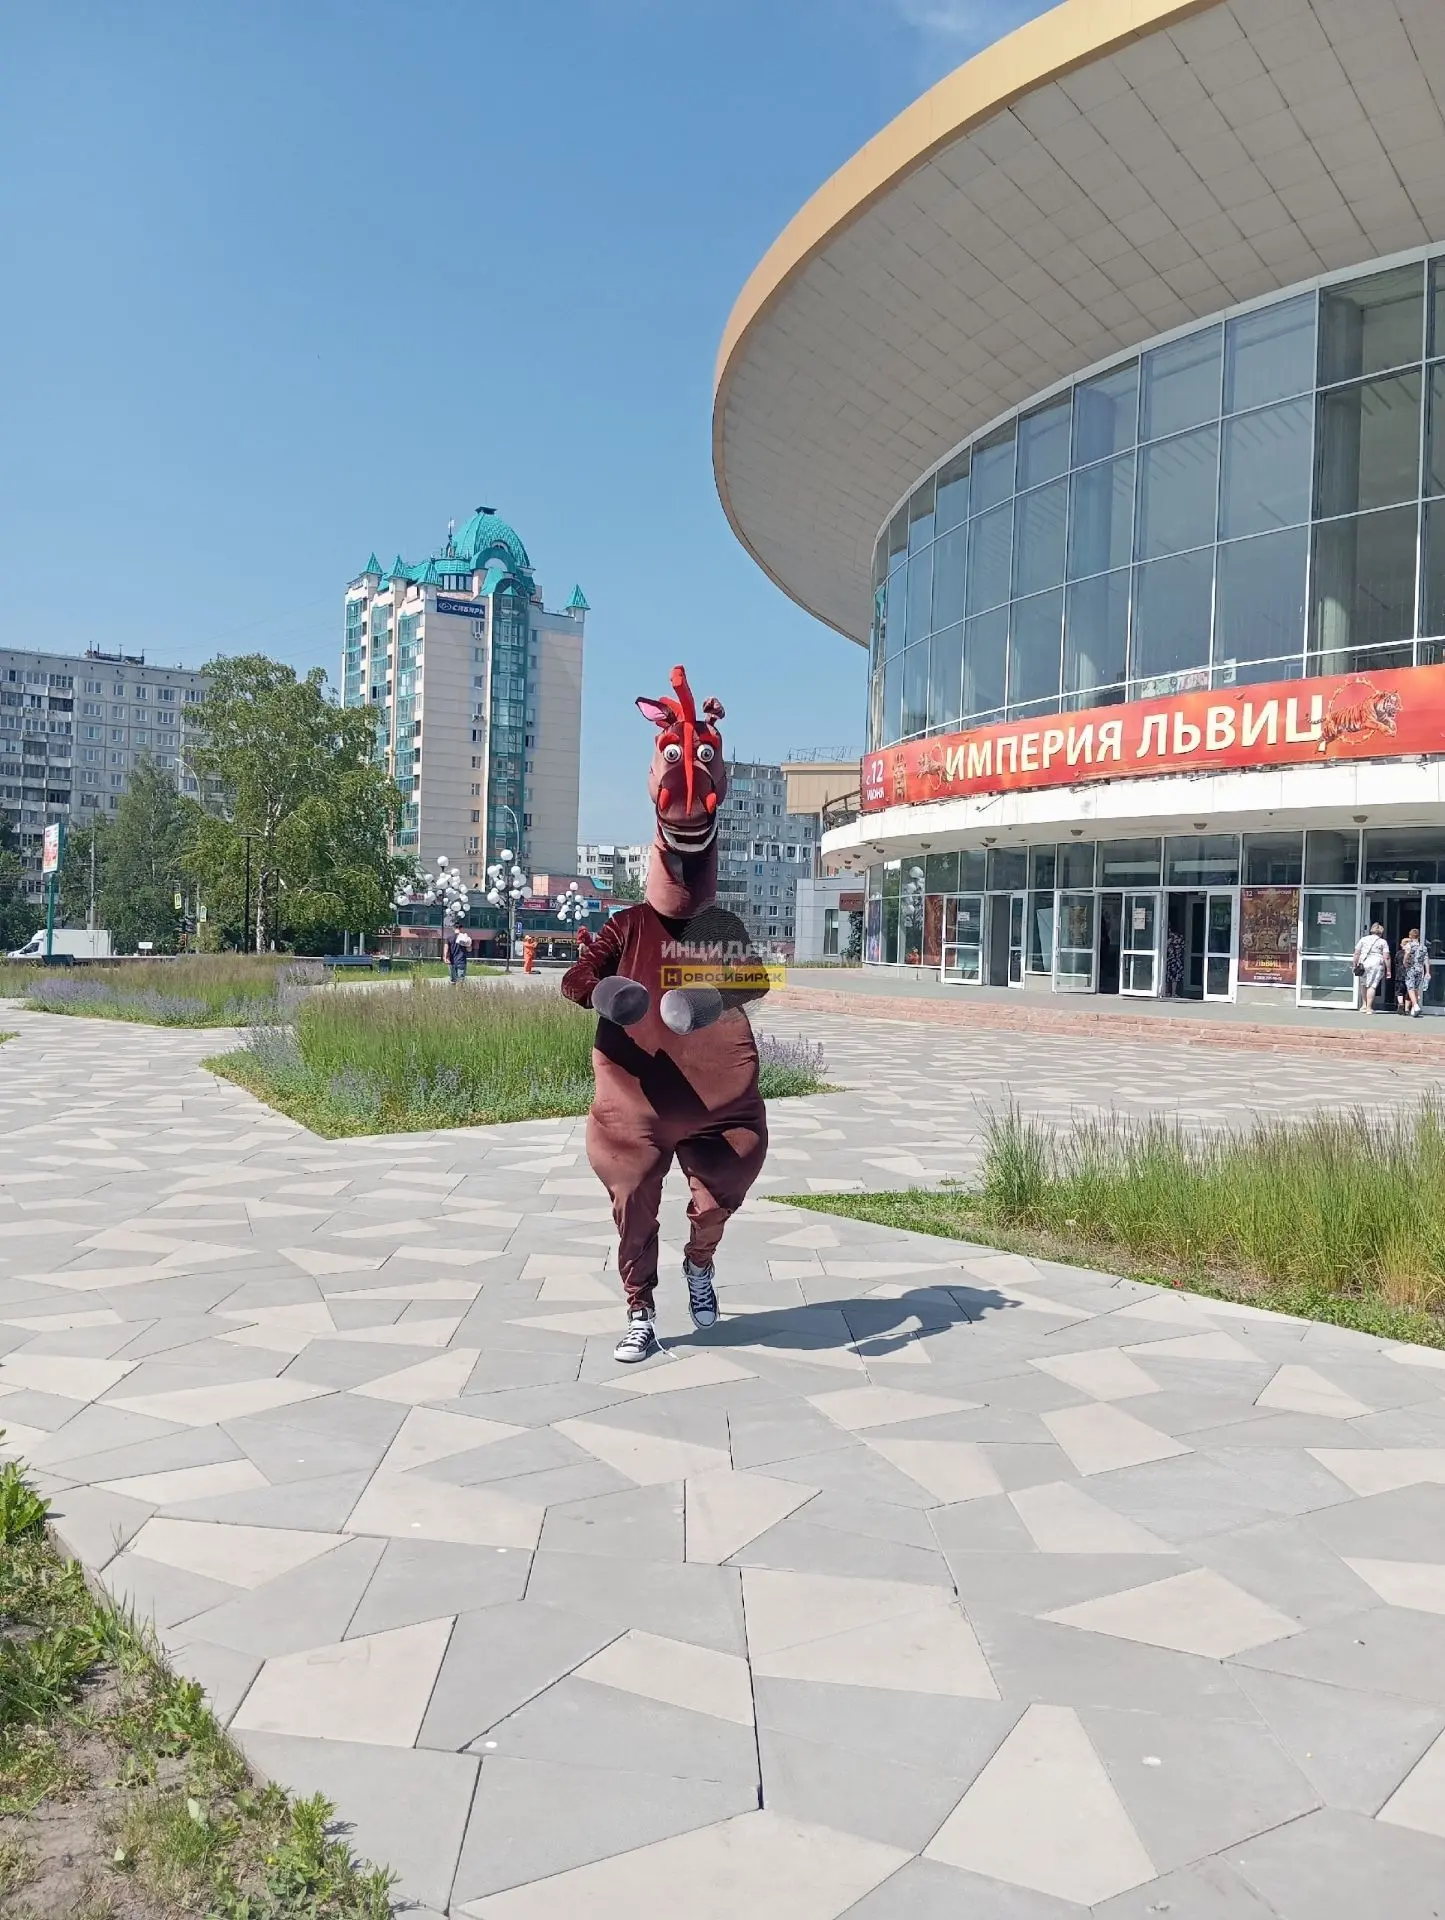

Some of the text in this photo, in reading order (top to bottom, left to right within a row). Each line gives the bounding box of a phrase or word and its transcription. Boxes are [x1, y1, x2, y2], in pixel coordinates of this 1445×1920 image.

[946, 694, 1326, 782] ИМПЕРИЯ ЛЬВИЦ
[871, 759, 884, 784] 12
